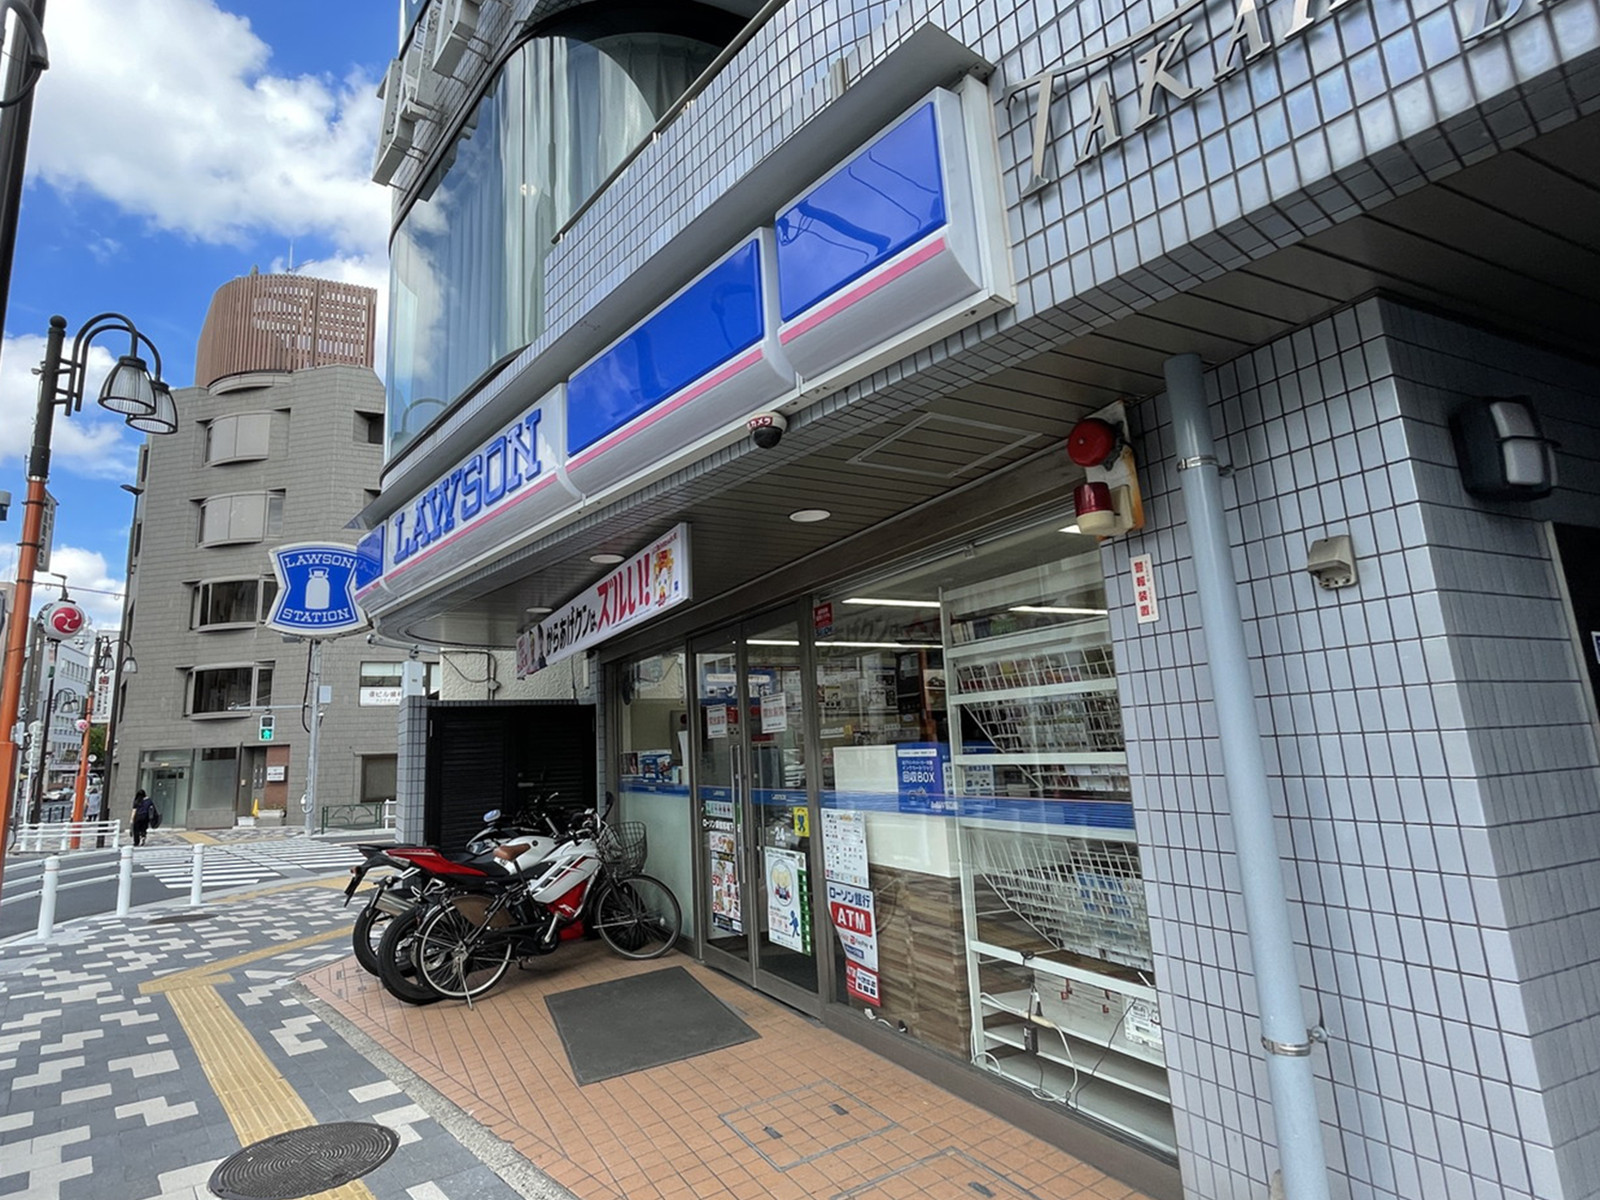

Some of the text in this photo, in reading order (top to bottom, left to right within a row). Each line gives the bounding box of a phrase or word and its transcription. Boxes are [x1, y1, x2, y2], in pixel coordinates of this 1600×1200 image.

[393, 408, 542, 566] LAWSON
[284, 552, 355, 569] LAWSON
[281, 607, 351, 623] STATION
[903, 771, 936, 783] 回収BOX
[829, 887, 870, 909] ローソン銀行
[837, 907, 866, 932] ATM
